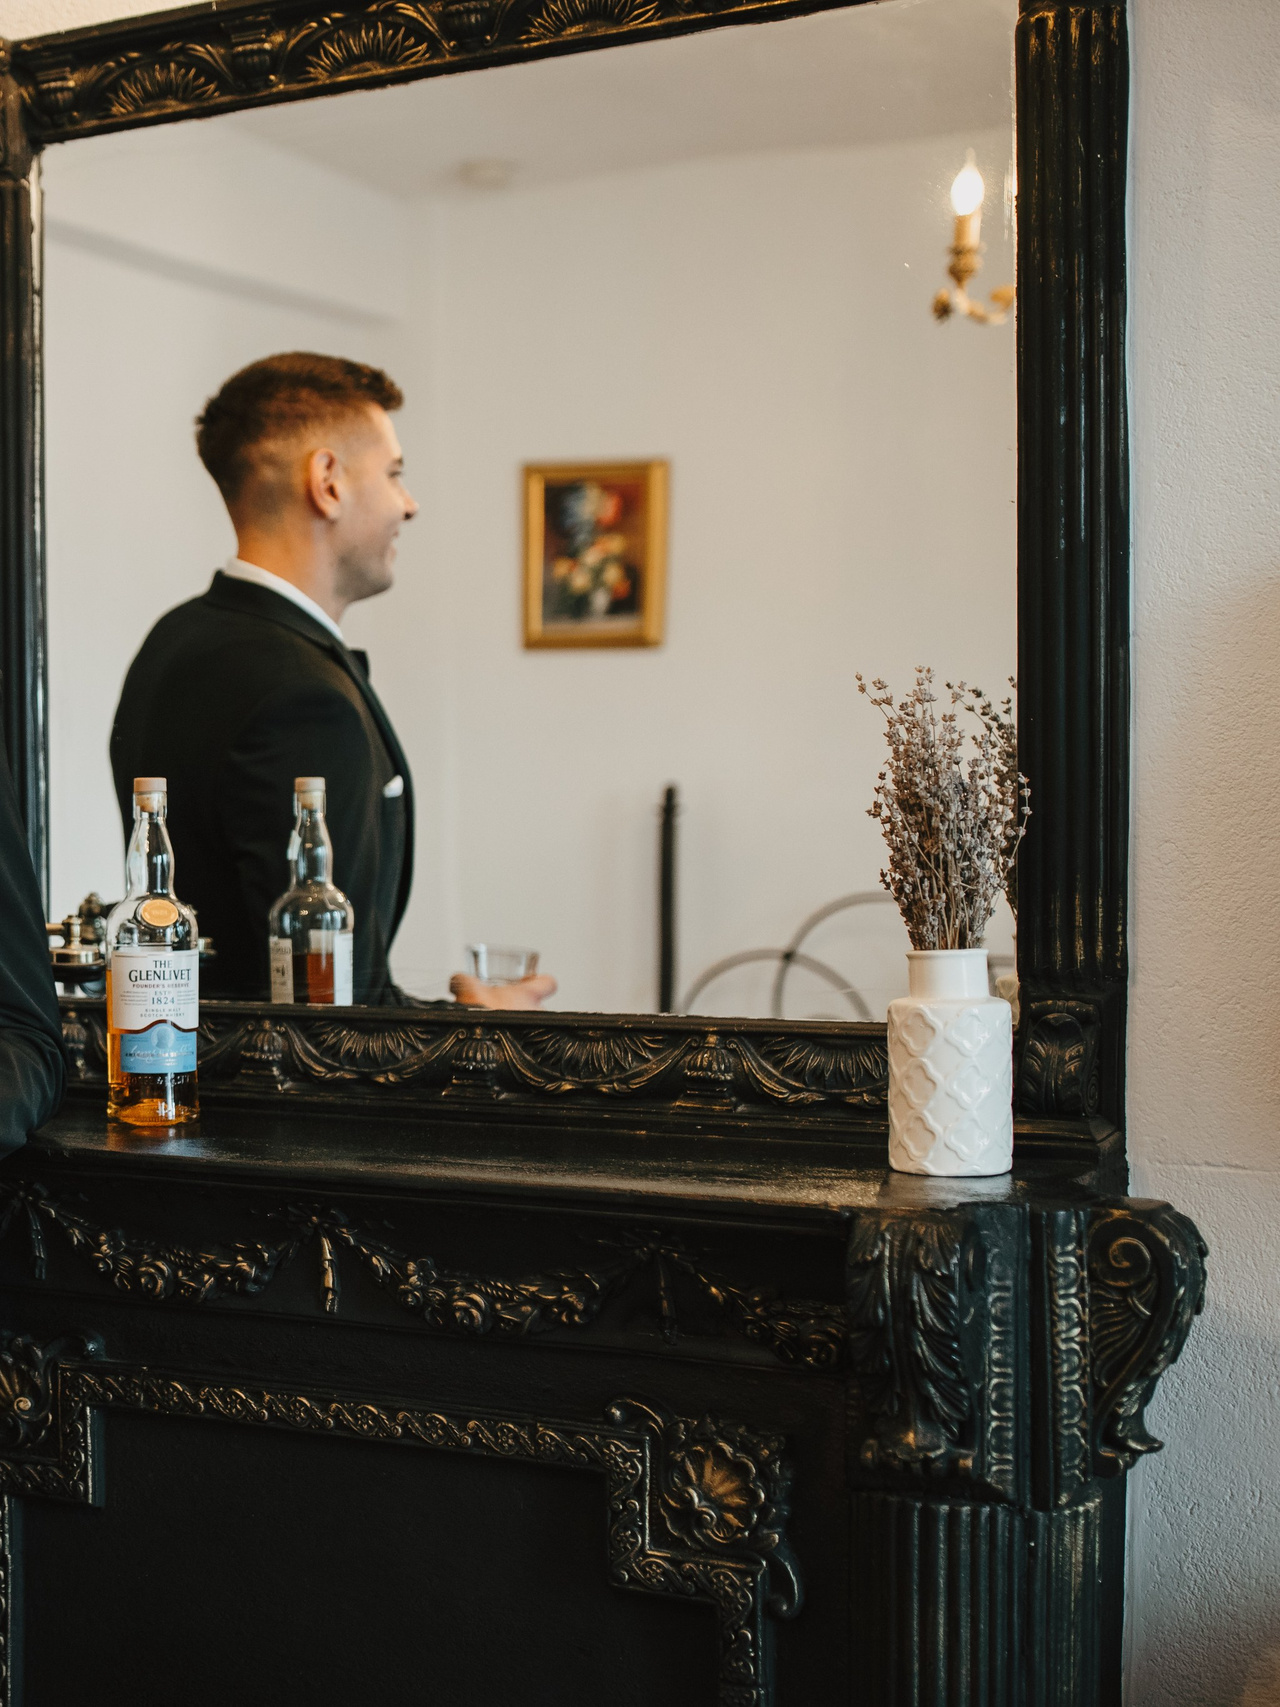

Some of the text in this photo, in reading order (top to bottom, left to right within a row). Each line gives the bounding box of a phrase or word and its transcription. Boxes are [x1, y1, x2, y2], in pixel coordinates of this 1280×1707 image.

[153, 960, 172, 968] THE
[129, 968, 191, 982] GLENLIVET
[151, 996, 175, 1005] 1824
